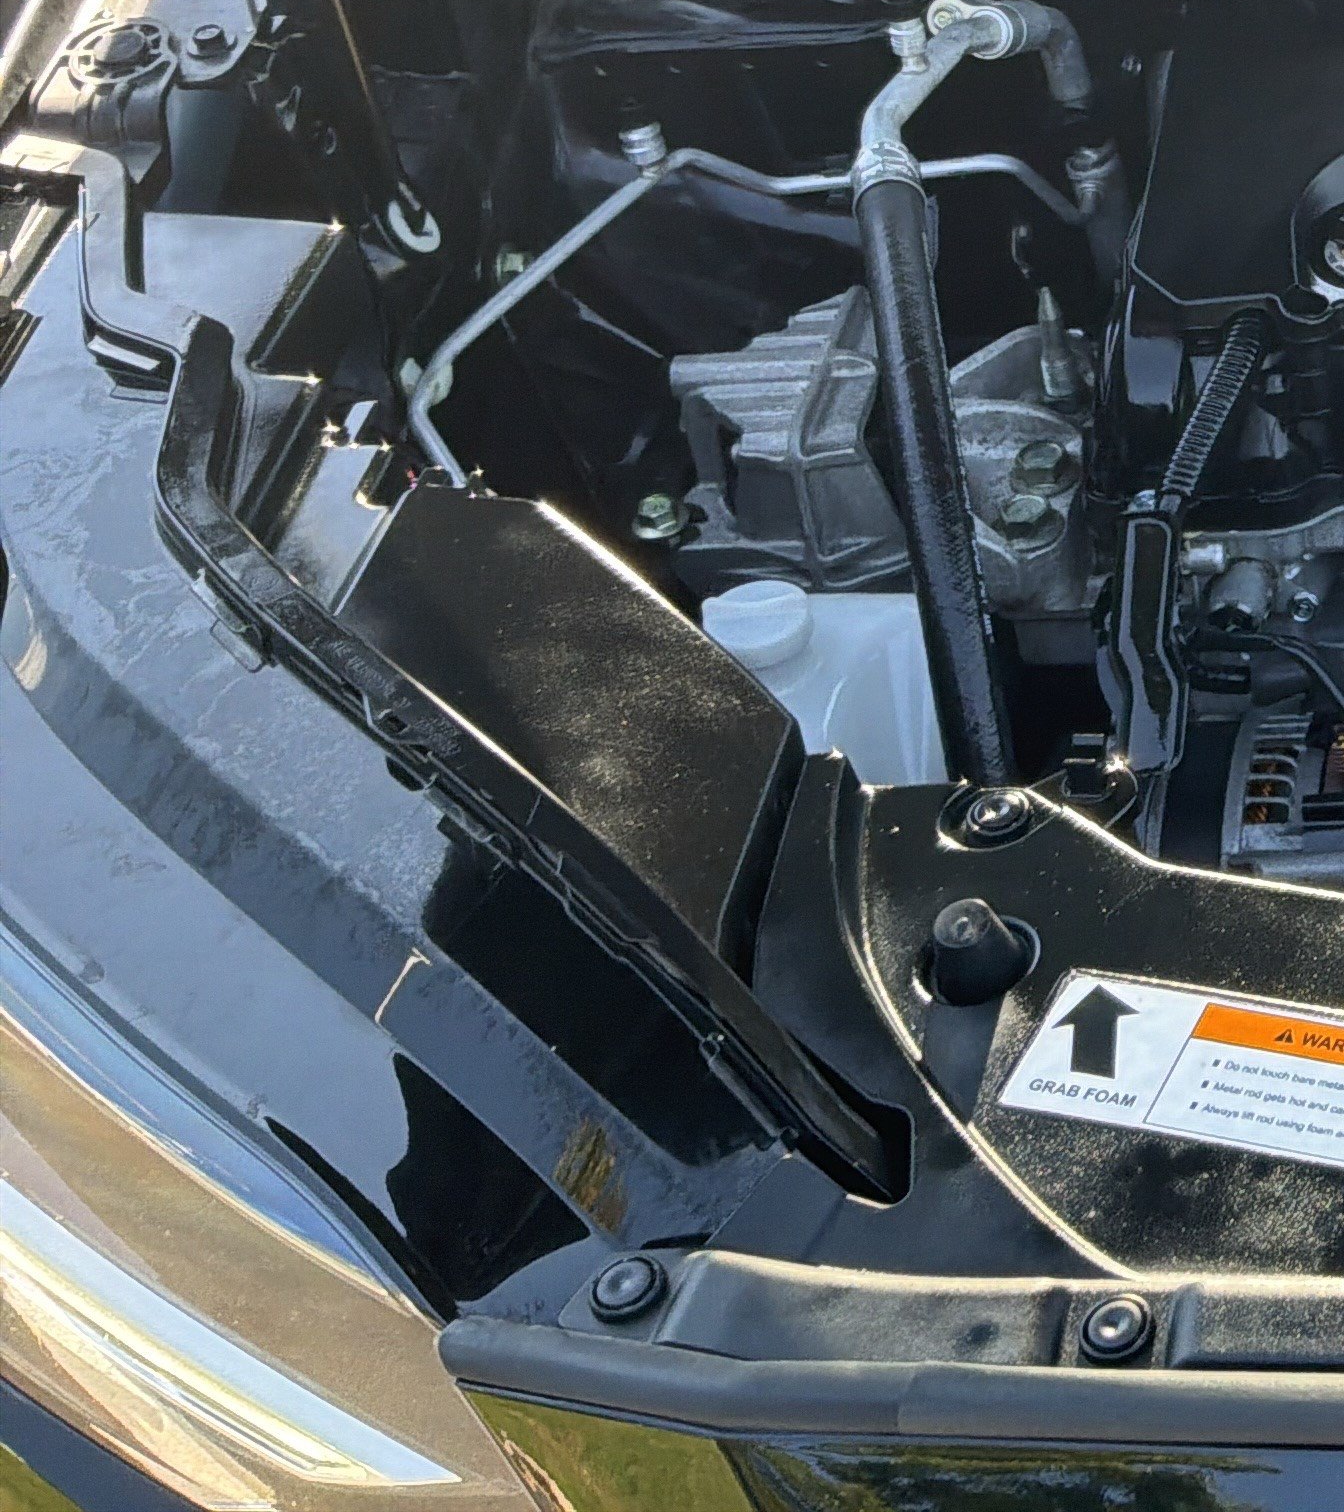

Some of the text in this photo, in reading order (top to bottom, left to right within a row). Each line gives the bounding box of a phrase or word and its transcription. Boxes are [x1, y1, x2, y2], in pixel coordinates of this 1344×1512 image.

[1225, 1060, 1240, 1071] Do
[1242, 1066, 1259, 1075] not
[1261, 1068, 1290, 1081] touch
[1292, 1074, 1316, 1086] bare
[1029, 1079, 1138, 1108] GRAB FOAM
[1213, 1082, 1244, 1095] Metal
[1244, 1090, 1263, 1099] rod
[1263, 1093, 1286, 1104] gets
[1289, 1096, 1307, 1107] hot
[1308, 1102, 1330, 1112] and
[1201, 1103, 1239, 1118] Always
[1241, 1110, 1256, 1121] lift
[1256, 1115, 1276, 1125] rod
[1276, 1118, 1305, 1133] using
[1307, 1122, 1334, 1136] foam
